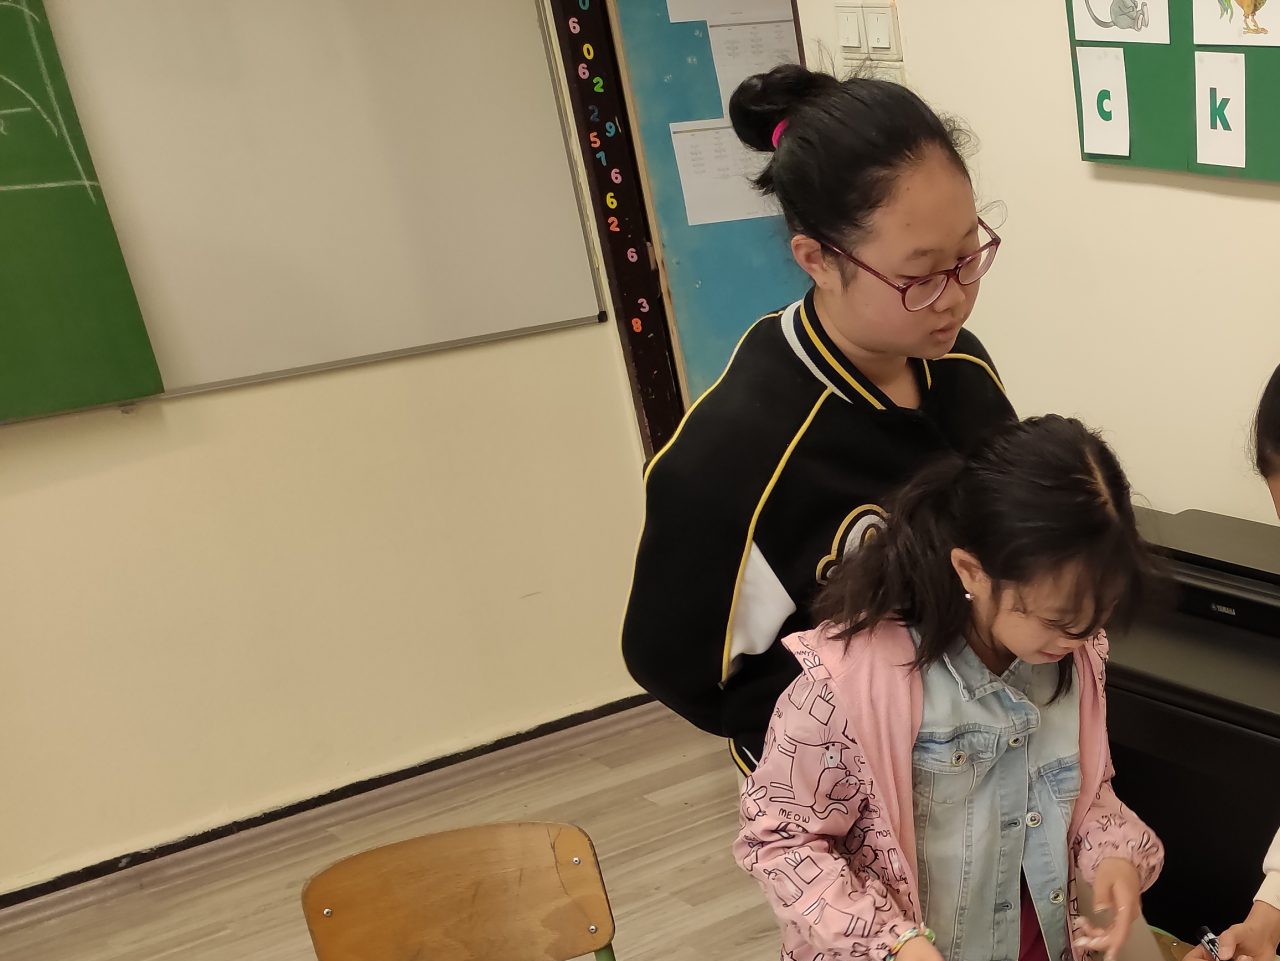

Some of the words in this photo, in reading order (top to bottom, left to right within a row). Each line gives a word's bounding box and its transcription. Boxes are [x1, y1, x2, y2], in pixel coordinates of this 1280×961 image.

[569, 17, 580, 34] 6
[583, 43, 594, 60] 0
[578, 63, 589, 79] 6
[593, 76, 604, 92] 2
[1096, 89, 1112, 122] c
[1209, 87, 1232, 131] k
[605, 122, 615, 137] 9
[589, 132, 600, 148] 5
[611, 168, 622, 184] 6
[606, 192, 617, 209] 6
[607, 216, 620, 232] 2
[627, 248, 638, 262] 6
[638, 298, 649, 312] 3
[631, 317, 642, 333] 8
[778, 807, 811, 824] MEOW
